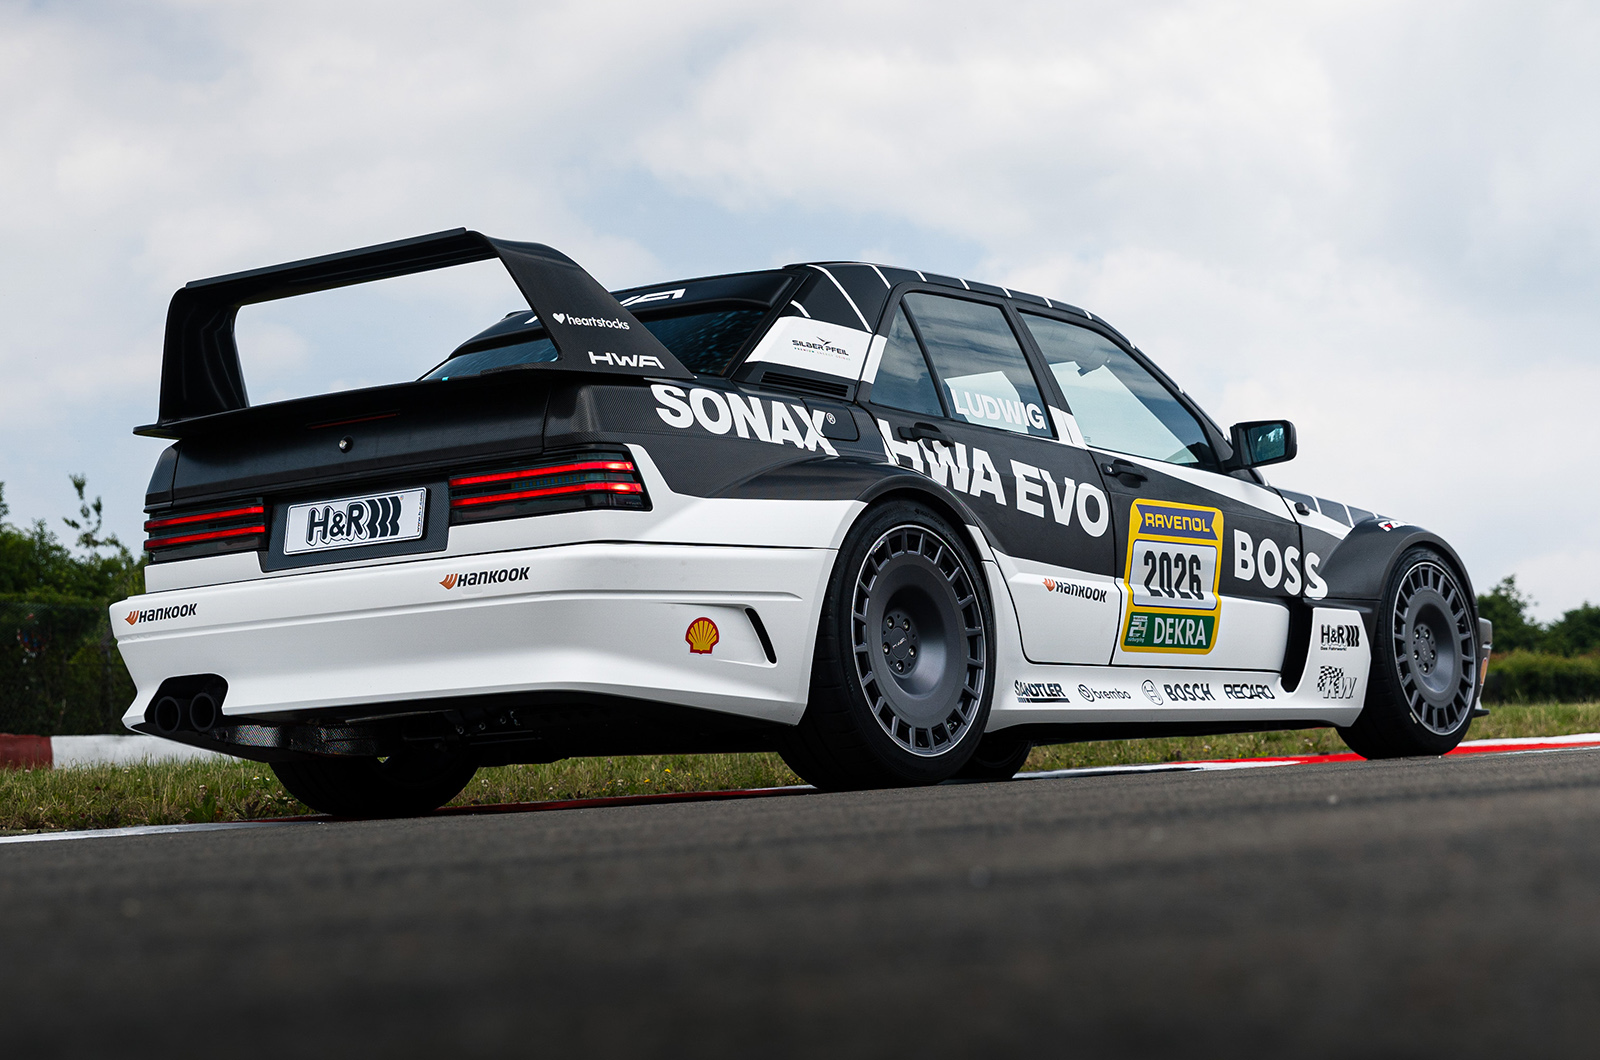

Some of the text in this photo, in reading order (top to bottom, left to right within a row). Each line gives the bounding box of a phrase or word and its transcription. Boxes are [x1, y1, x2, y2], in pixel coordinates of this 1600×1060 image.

[565, 313, 630, 331] heartstocks
[587, 351, 665, 370] HWA
[949, 388, 1047, 430] LUDWIG
[876, 417, 1109, 538] HWA EVO
[1145, 512, 1211, 533] RAVENOL
[1143, 550, 1204, 600] 2026
[1233, 528, 1329, 601] BOSS
[1153, 616, 1207, 646] DEKRA
[1090, 687, 1132, 700] brembo
[1163, 683, 1216, 702] BOSCH
[1223, 683, 1276, 700] RECARO
[1322, 677, 1357, 699] KW
